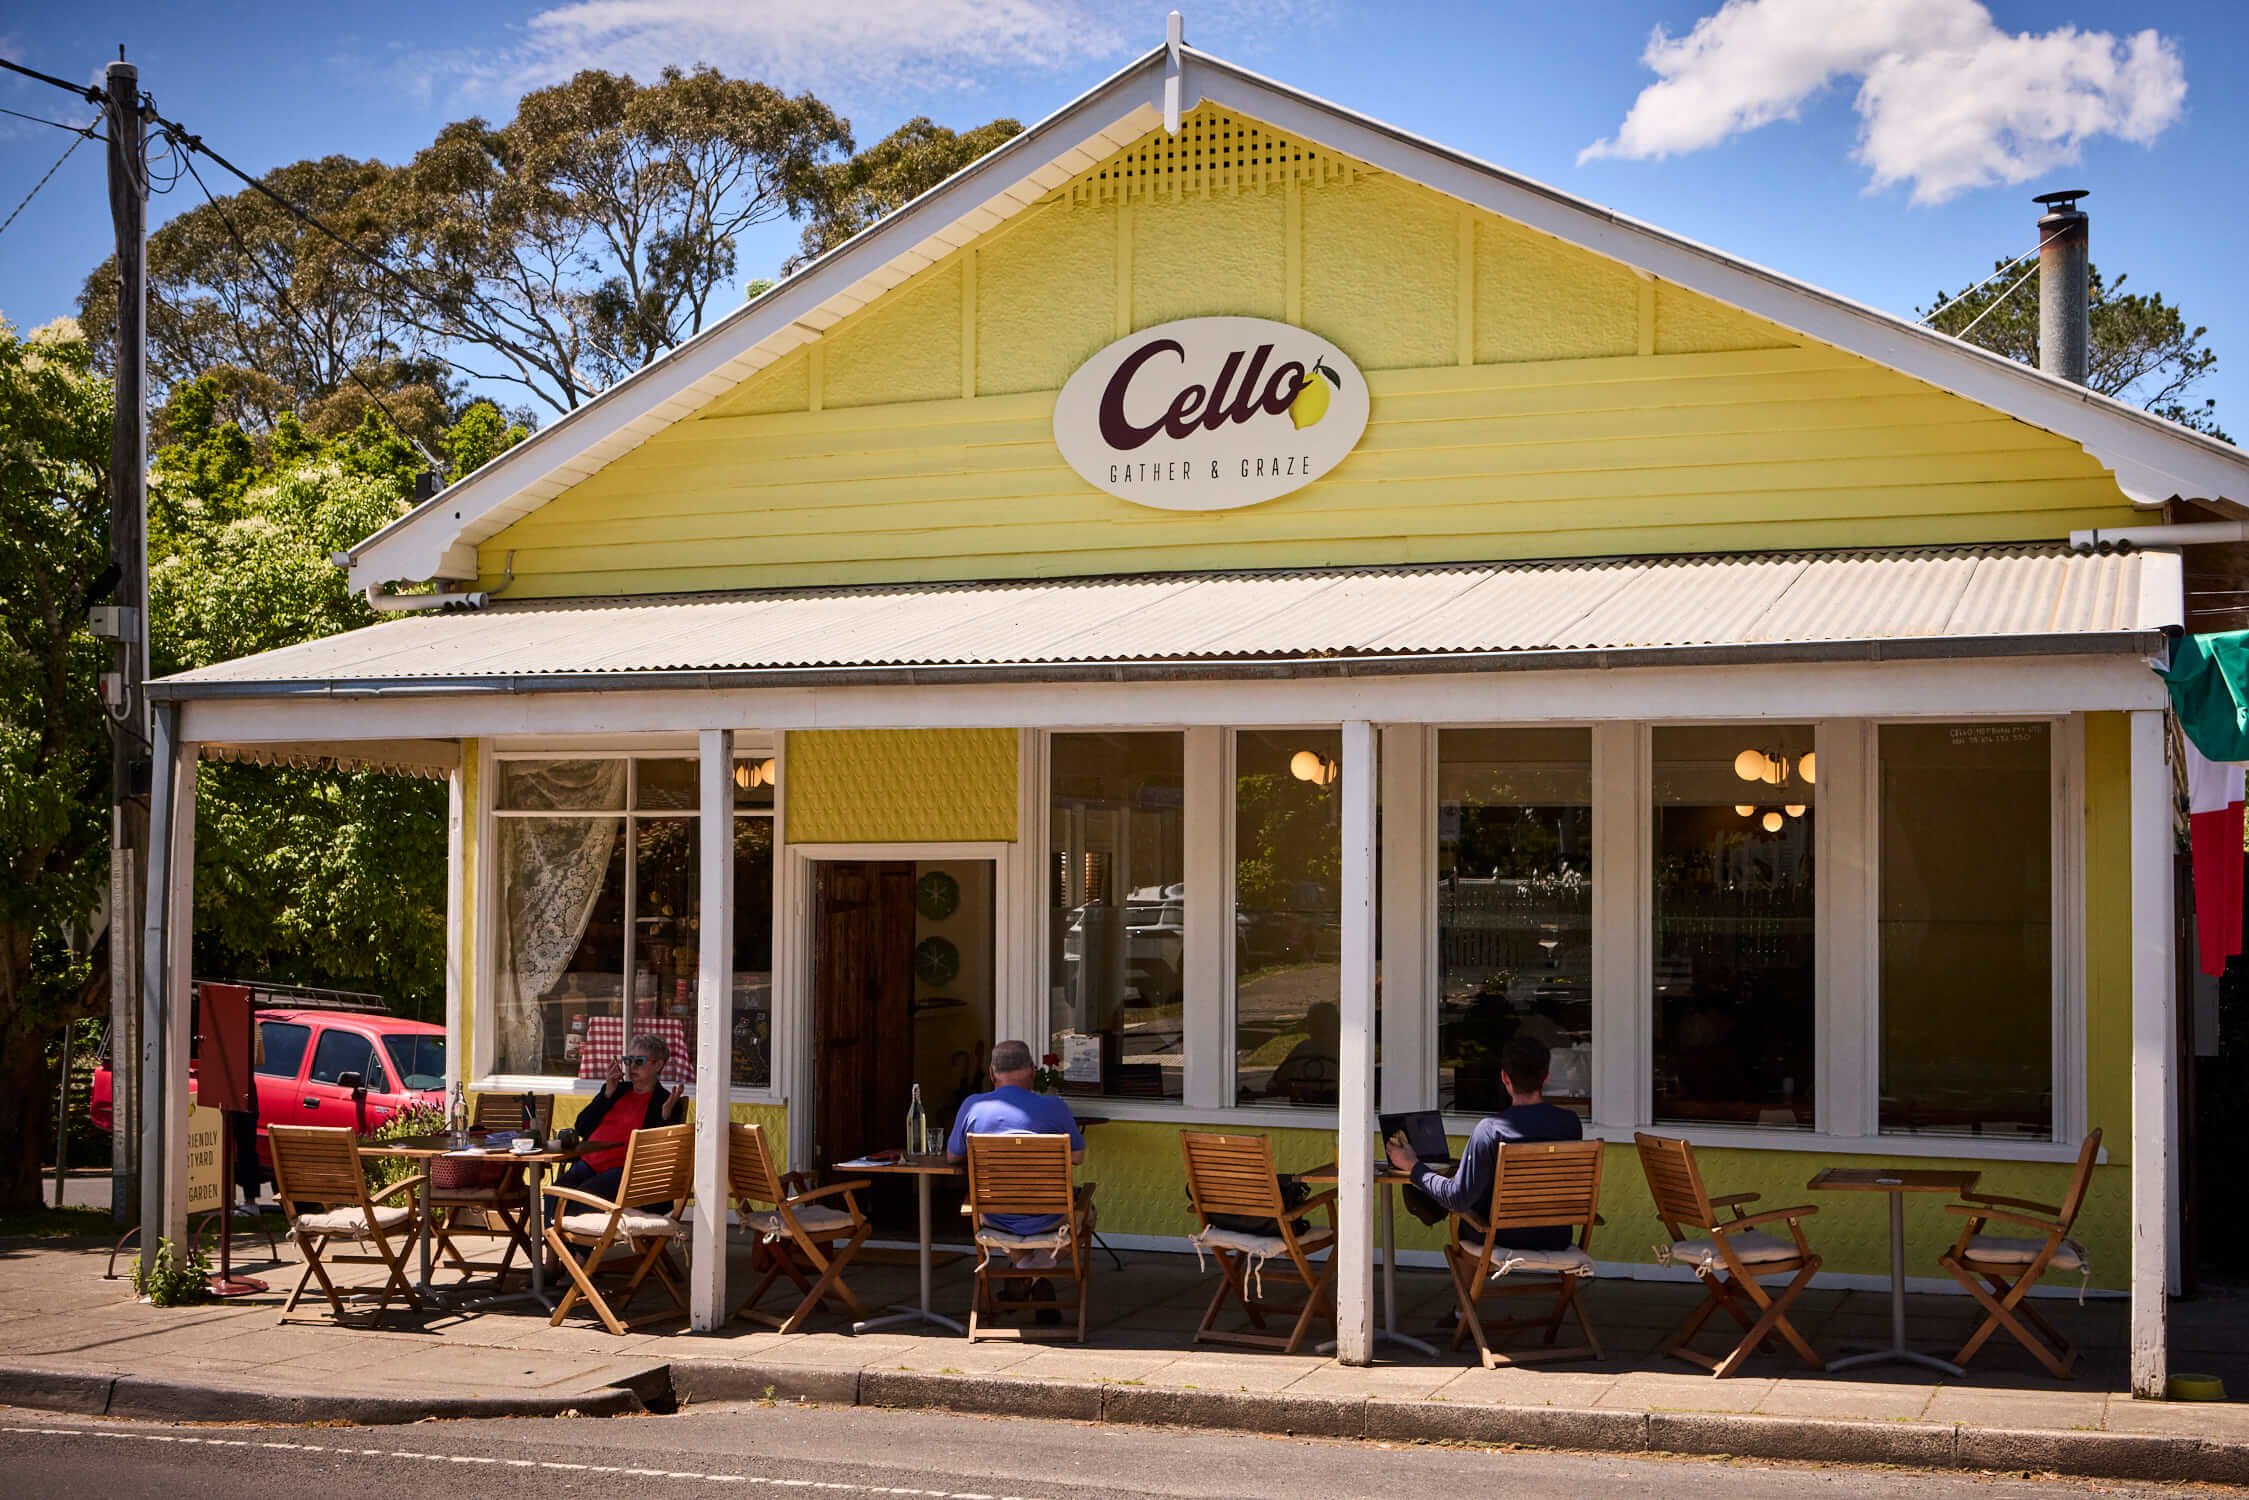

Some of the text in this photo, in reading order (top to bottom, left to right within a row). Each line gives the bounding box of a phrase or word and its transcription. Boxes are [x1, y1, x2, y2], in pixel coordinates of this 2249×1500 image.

[1099, 338, 1314, 451] Cello
[1110, 456, 1311, 484] GATHER & GRAZE
[188, 1184, 218, 1202] GARDEN
